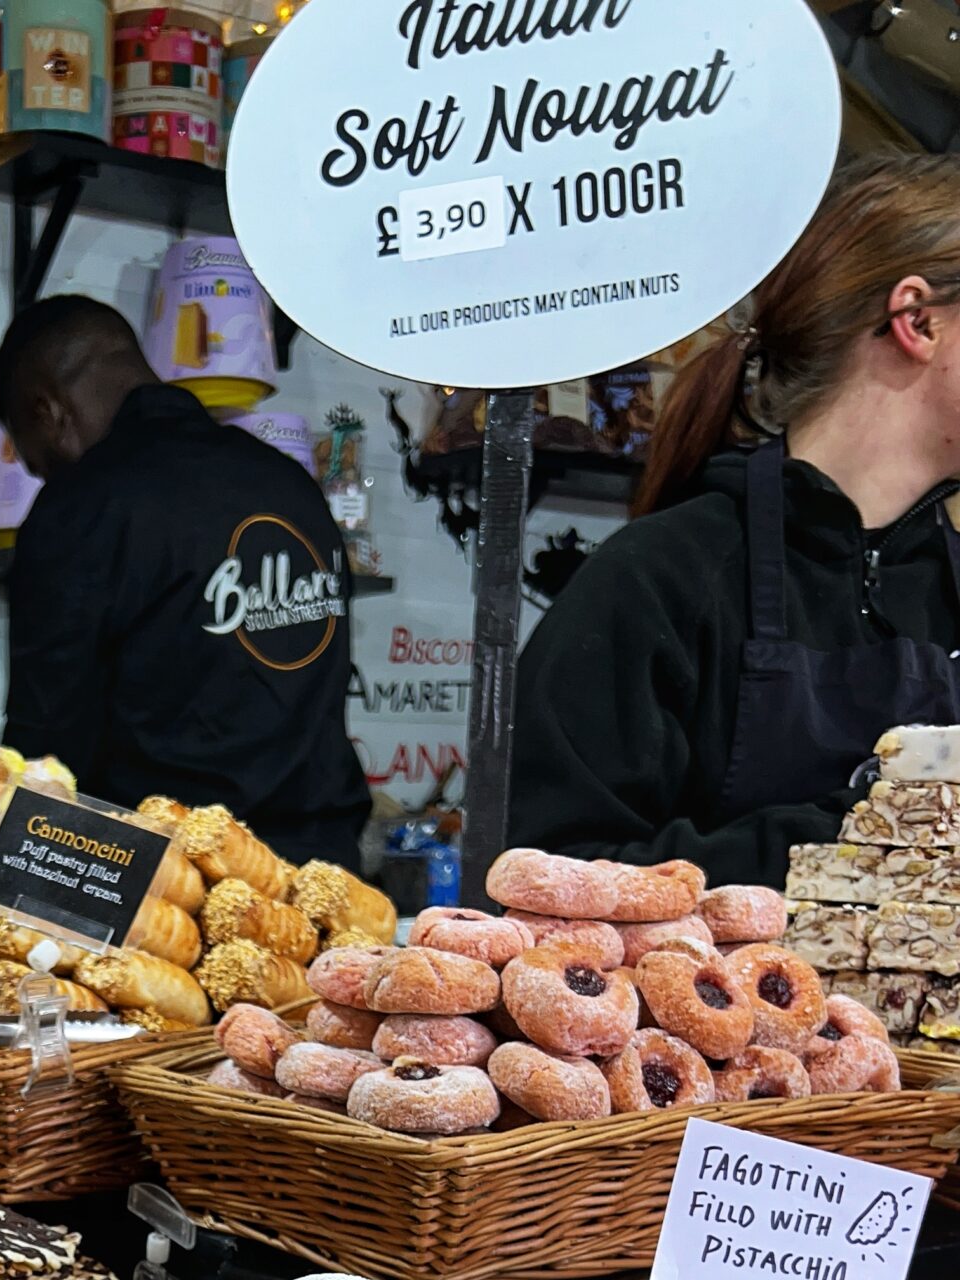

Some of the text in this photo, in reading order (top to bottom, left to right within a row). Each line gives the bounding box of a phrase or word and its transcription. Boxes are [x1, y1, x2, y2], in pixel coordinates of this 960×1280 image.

[321, 49, 734, 187] Soft Nougat
[507, 182, 535, 236] X
[552, 158, 685, 227] 100GR
[390, 273, 680, 338] ALL OUR PRODUCTS MAY CONTAIN NUTS
[20, 840, 121, 884] Puff pastry filled
[27, 816, 136, 866] Cannoncini
[3, 855, 26, 871] with
[26, 860, 79, 889] hazelnut
